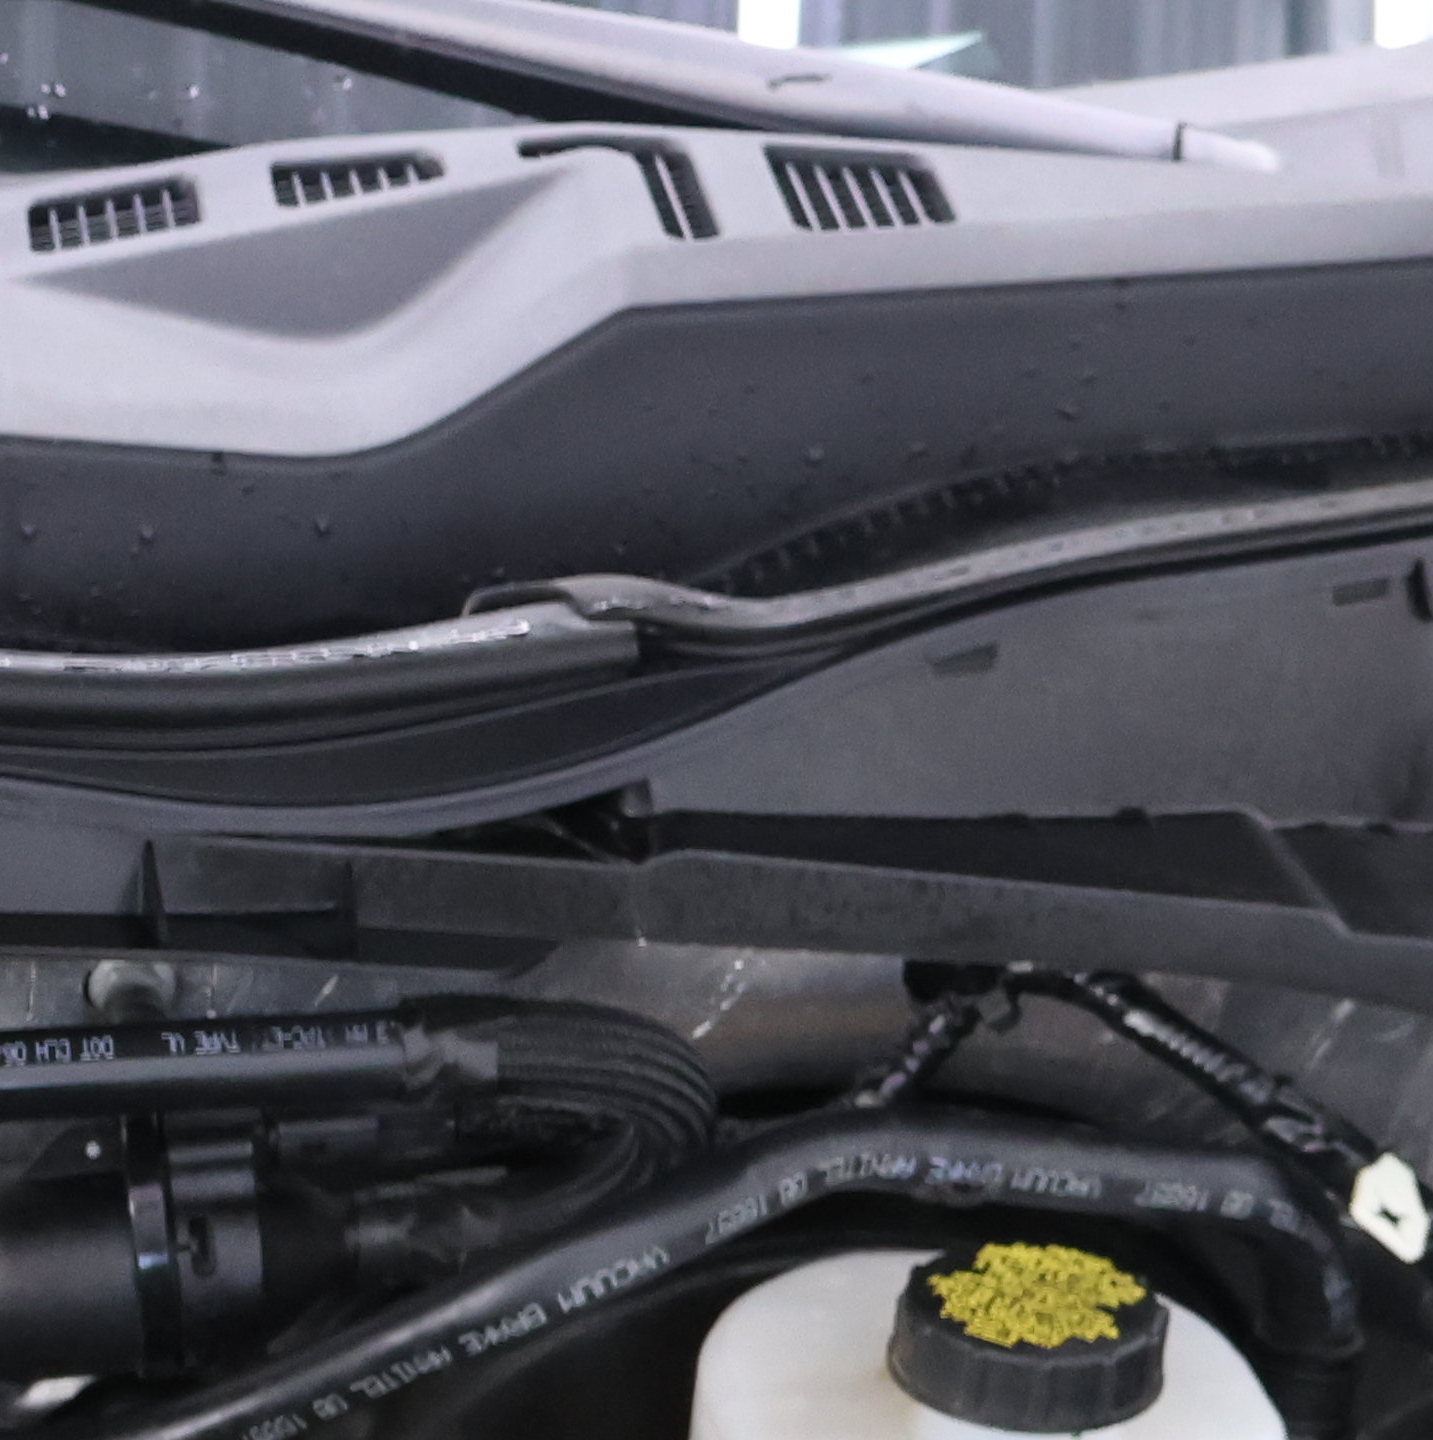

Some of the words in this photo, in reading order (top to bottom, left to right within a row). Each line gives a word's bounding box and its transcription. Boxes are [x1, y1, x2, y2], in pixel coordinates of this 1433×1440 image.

[81, 1034, 115, 1061] DOT
[558, 1244, 671, 1315] VACUUM
[457, 1301, 548, 1360] BRAKE
